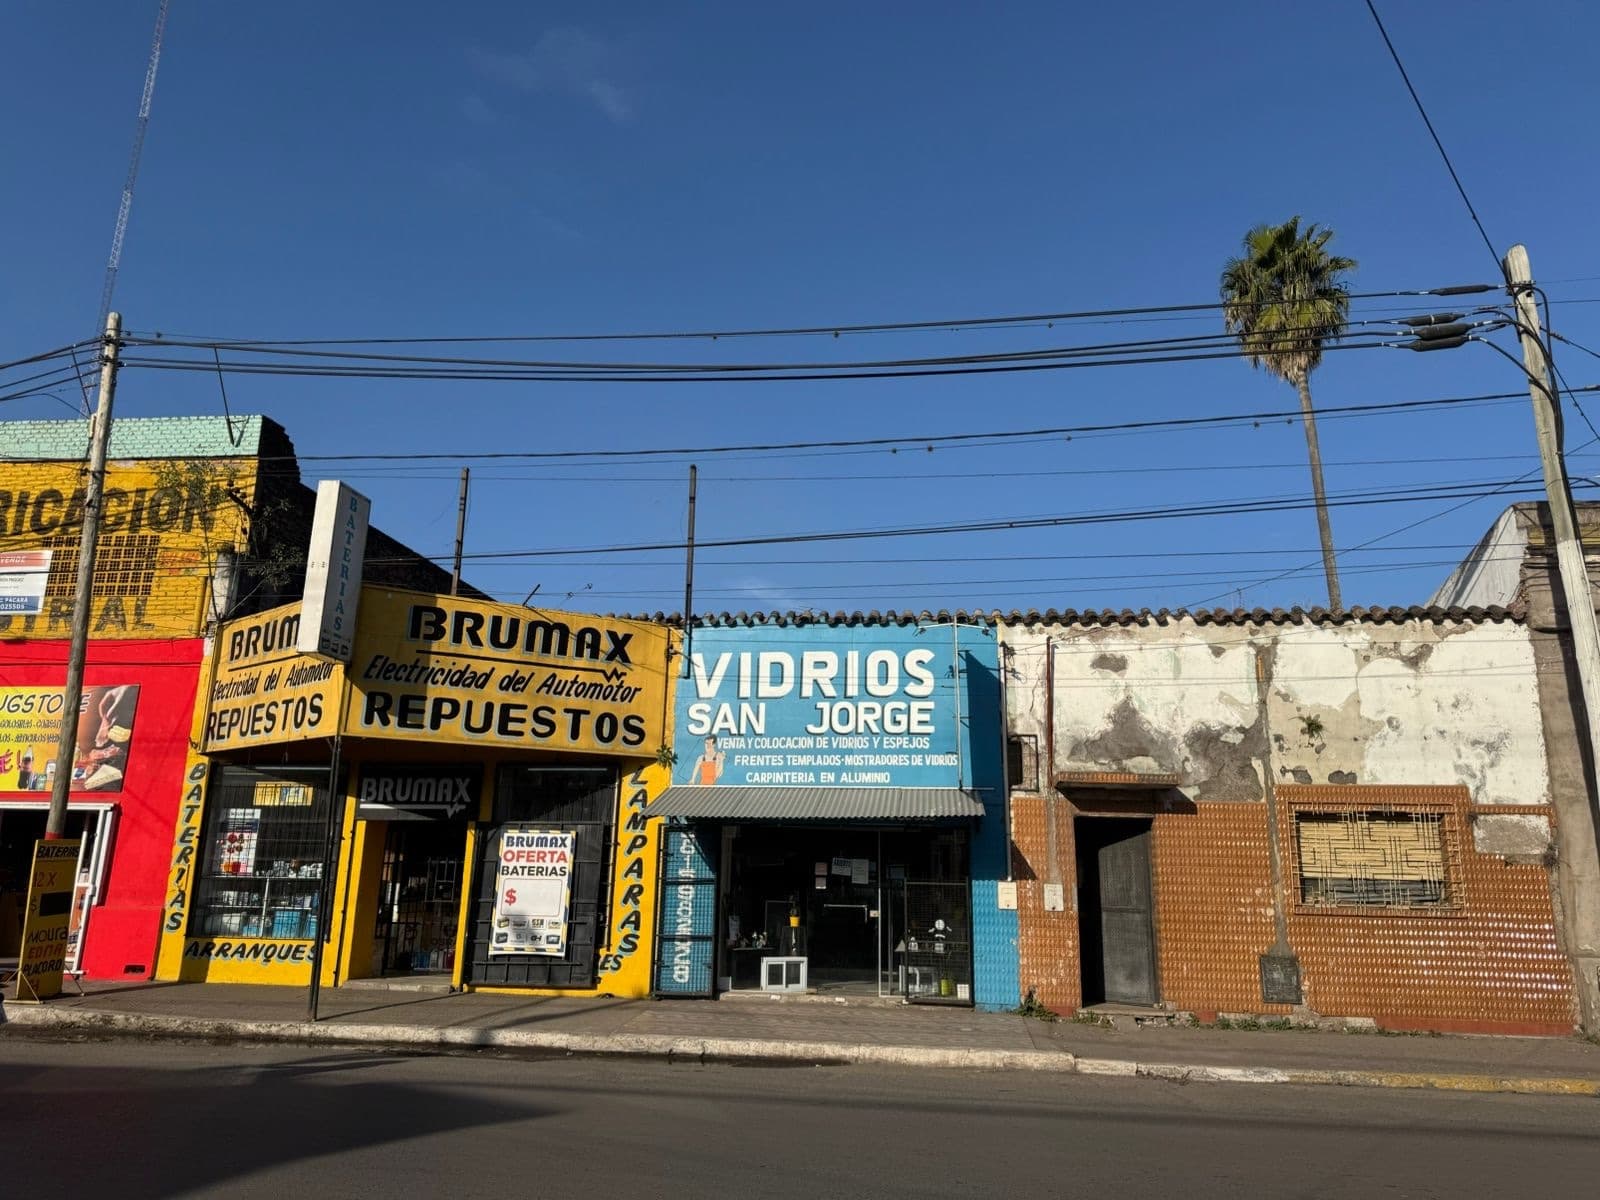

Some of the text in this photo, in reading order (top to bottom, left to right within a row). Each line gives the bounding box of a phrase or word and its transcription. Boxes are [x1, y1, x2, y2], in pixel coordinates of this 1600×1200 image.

[332, 496, 358, 631] BATERIAS
[409, 605, 634, 665] BRUMAX
[211, 660, 336, 702] Electricidad del Automotor
[363, 654, 643, 704] Electricidad del Automotor
[691, 648, 936, 699] VIDRIOS
[206, 692, 325, 741] REPUESTOS
[362, 690, 647, 747] REPUESTOS
[686, 700, 936, 735] SAN JORGE
[717, 736, 930, 750] VENTA Y COLOCACION DE VIDRIOS Y ESPEJOS
[734, 754, 784, 766] FRENTES
[911, 754, 923, 766] DE
[924, 754, 958, 767] VIDRIOS
[360, 777, 472, 803] BRUMAX
[746, 771, 890, 784] CARPINTERIA EN ALUMINIO
[165, 762, 206, 932] BATERIAS
[503, 850, 568, 863] OFERTA
[505, 835, 569, 848] BRUMAX
[501, 865, 567, 877] BATERIAS
[618, 765, 649, 954] LAMPARAS
[505, 887, 517, 906] $
[184, 942, 316, 964] ARRANQUES
